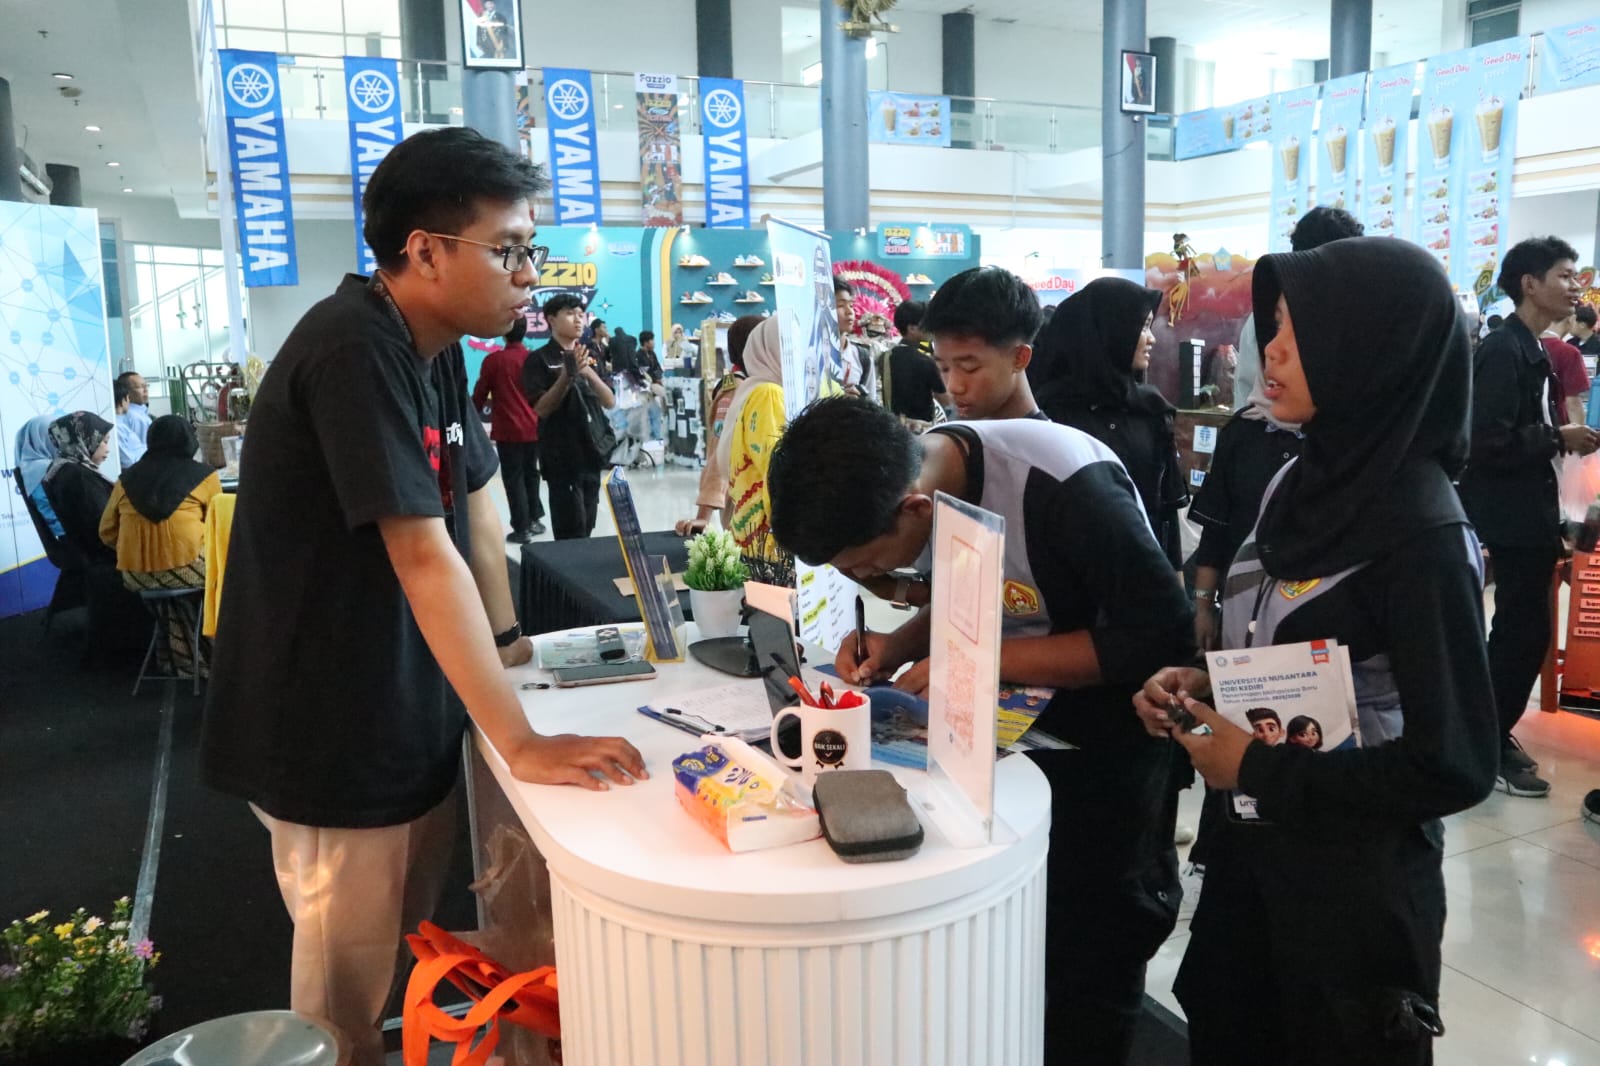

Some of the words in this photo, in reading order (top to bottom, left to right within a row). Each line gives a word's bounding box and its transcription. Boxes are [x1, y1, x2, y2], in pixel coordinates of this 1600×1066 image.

[640, 73, 671, 84] Fazzio
[554, 123, 597, 227] YAMA
[708, 131, 745, 229] YAMA
[233, 112, 289, 271] YAMAHA
[536, 262, 597, 287] ZZIO
[1055, 276, 1075, 292] Day
[1219, 677, 1268, 686] UNIVERSITAS
[1268, 671, 1318, 681] NUSANTARA
[1239, 683, 1264, 691] KEDIRI
